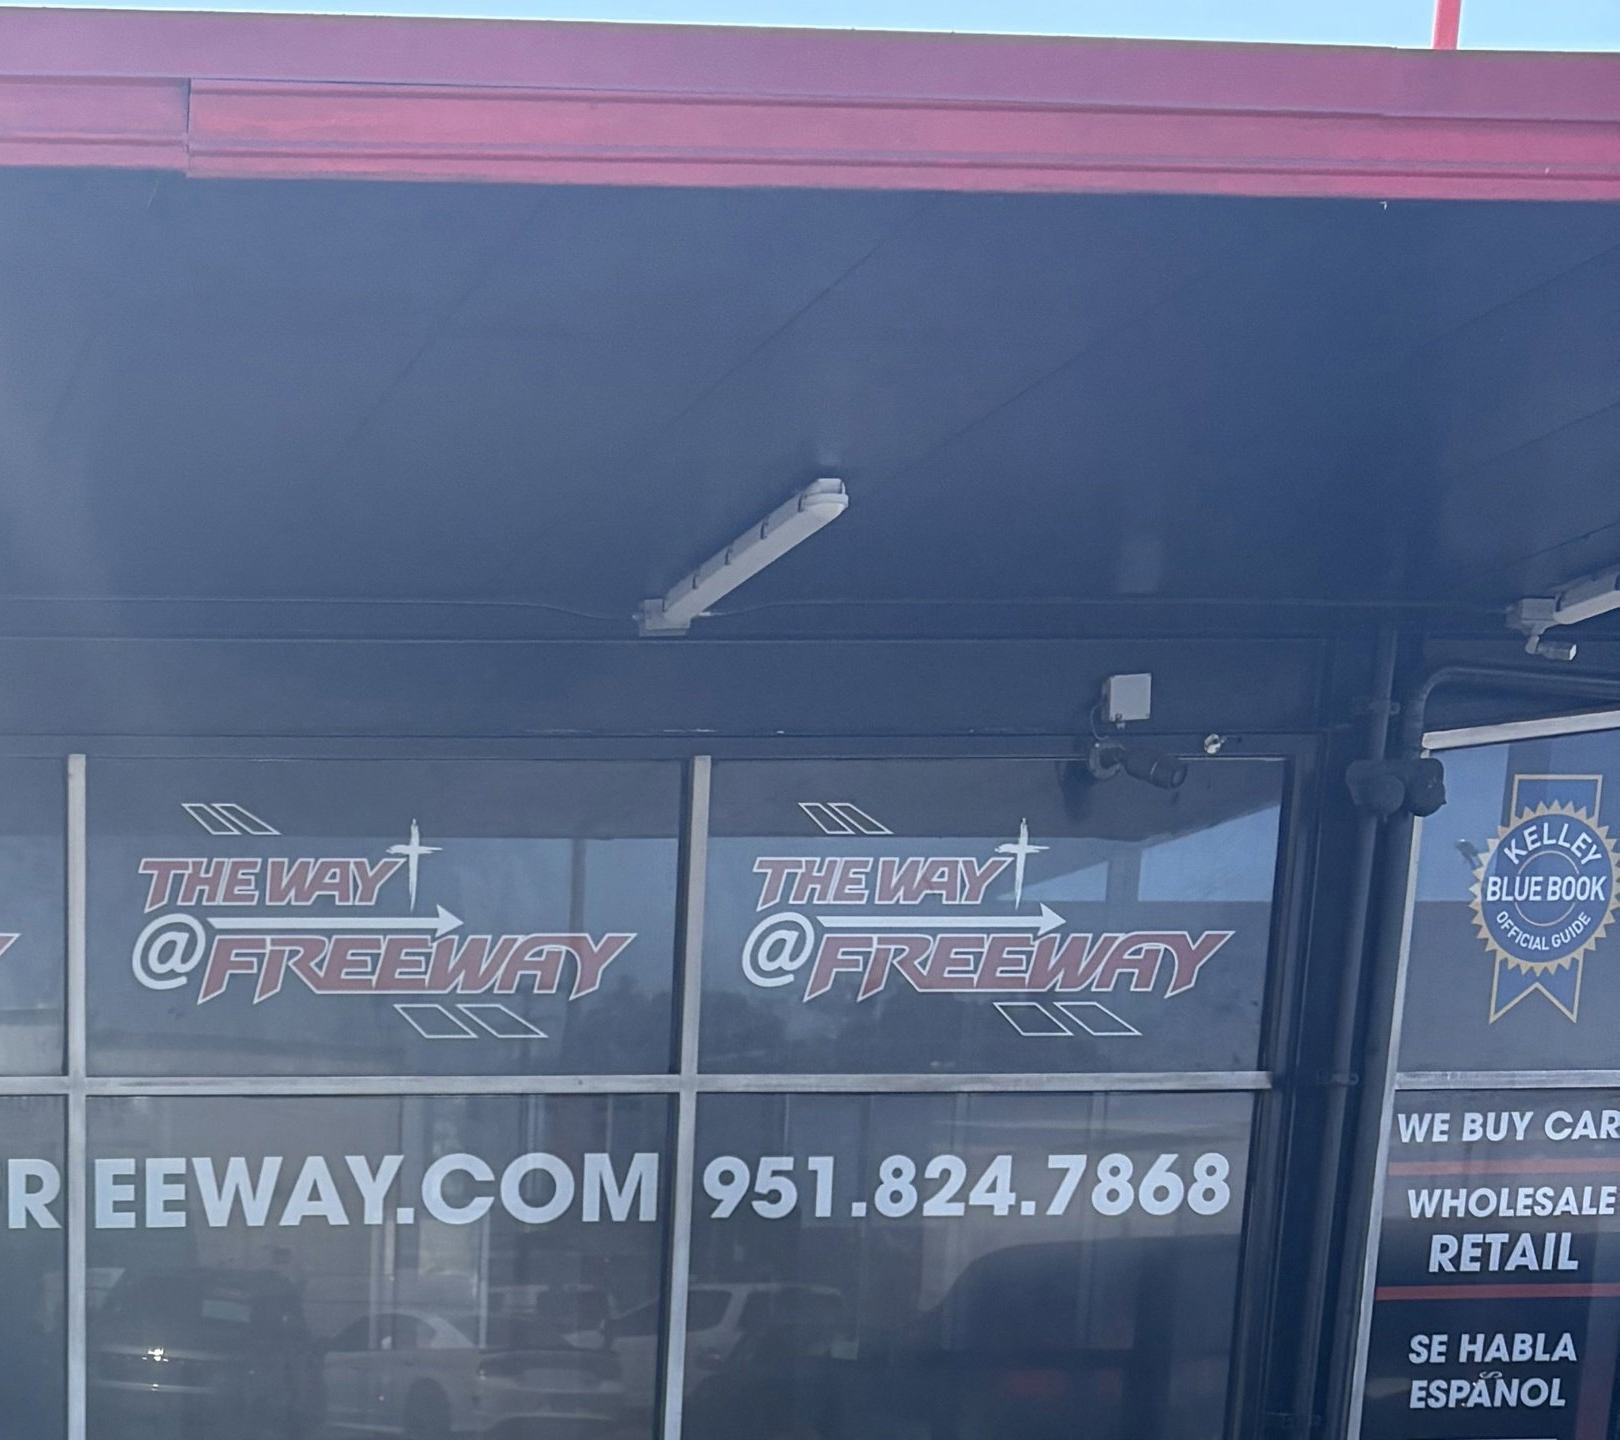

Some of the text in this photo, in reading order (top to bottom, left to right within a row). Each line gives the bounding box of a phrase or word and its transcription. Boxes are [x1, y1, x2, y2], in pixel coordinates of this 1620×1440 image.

[1504, 822, 1601, 865] KELLEY
[1486, 876, 1607, 901] BLUE BOOK
[1496, 911, 1591, 950] OFFICIAL GUIDE
[132, 913, 638, 1004] @FREEWAY
[742, 912, 1236, 1003] @FREEWAY
[1397, 1110, 1620, 1143] WE BUY CAR
[703, 1153, 1230, 1219] 951.824.7868
[1407, 1186, 1617, 1219] WHOLESALE
[1428, 1232, 1579, 1273] RETAIL
[1409, 1333, 1578, 1364] SE HABLA
[1409, 1371, 1566, 1410] ESPAÑOL
